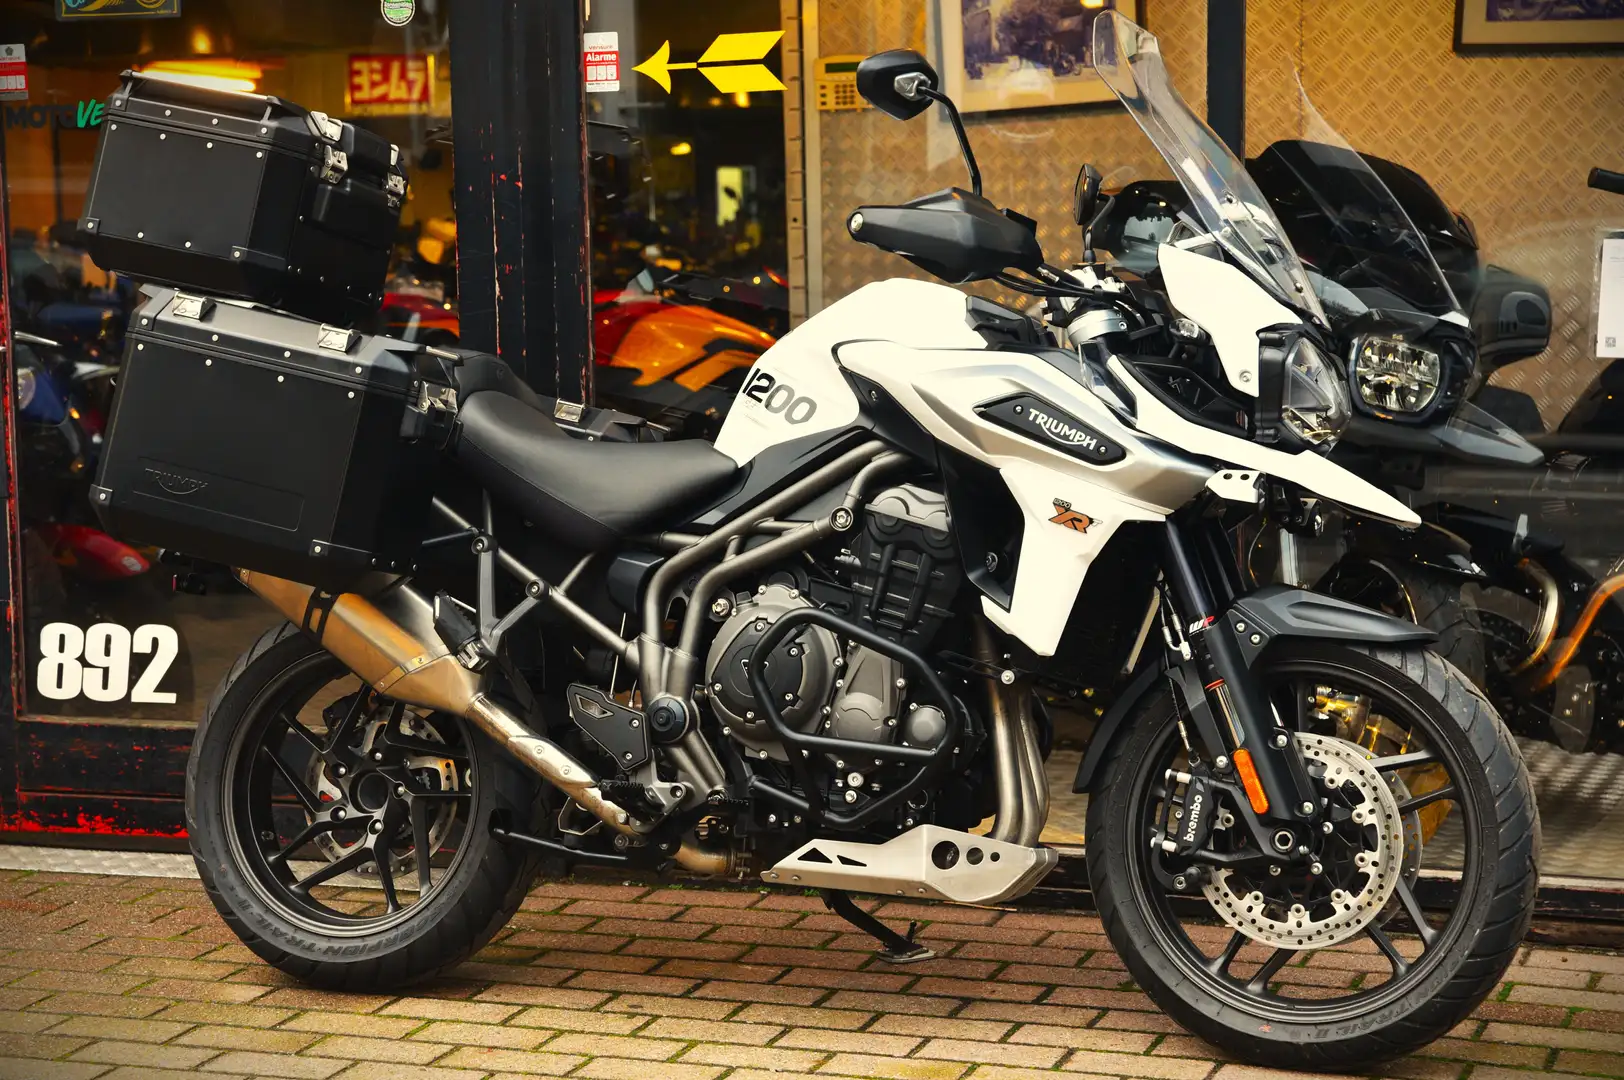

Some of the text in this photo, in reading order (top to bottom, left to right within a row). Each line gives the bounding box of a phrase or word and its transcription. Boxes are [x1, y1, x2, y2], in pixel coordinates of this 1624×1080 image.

[586, 52, 616, 62] Alarme
[352, 60, 426, 100] ヨシムラ
[742, 368, 818, 425] 1200
[1028, 408, 1098, 451] TRIUMPH
[144, 467, 209, 494] TRIUMPH
[1189, 615, 1215, 634] WP
[37, 622, 179, 704] 892
[1183, 794, 1203, 842] brembo
